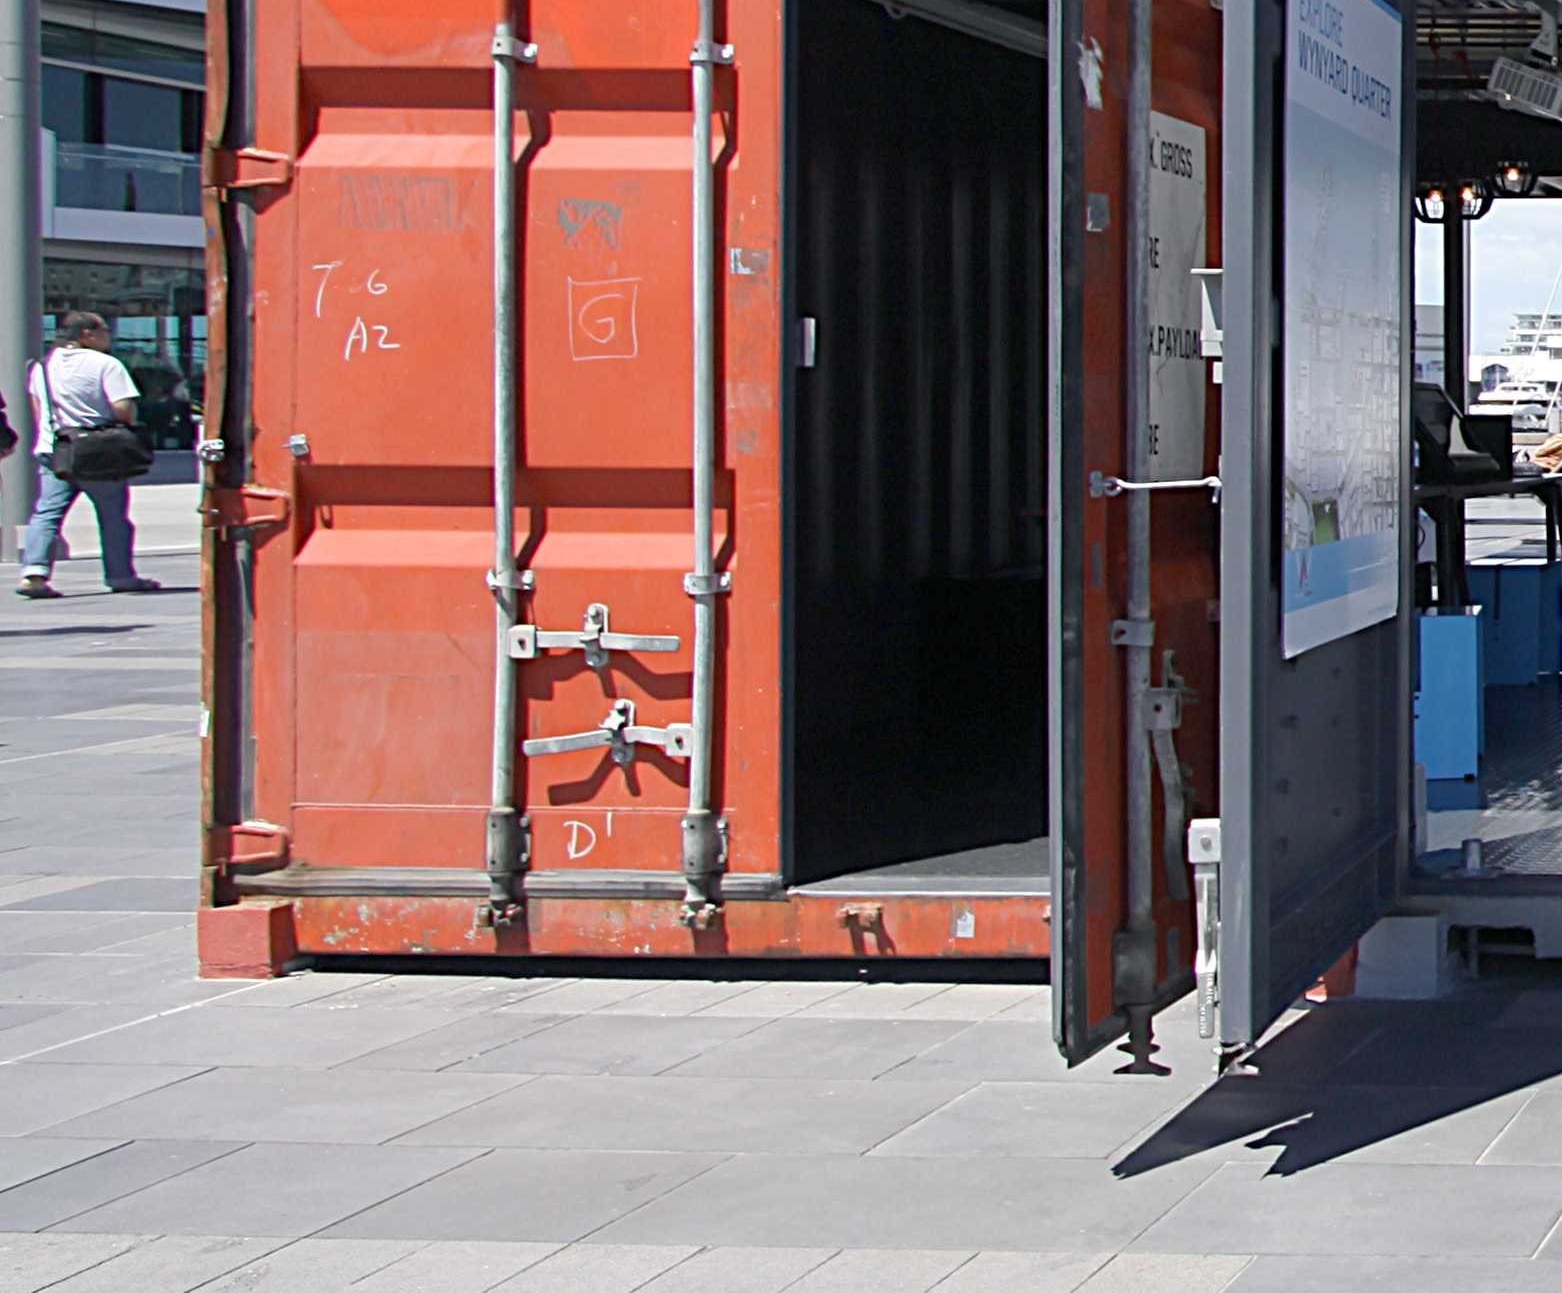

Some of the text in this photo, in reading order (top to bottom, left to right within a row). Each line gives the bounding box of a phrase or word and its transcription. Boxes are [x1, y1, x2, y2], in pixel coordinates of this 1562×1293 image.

[1298, 28, 1391, 121] WYNYARD QUARTER
[1161, 140, 1193, 179] GROSS
